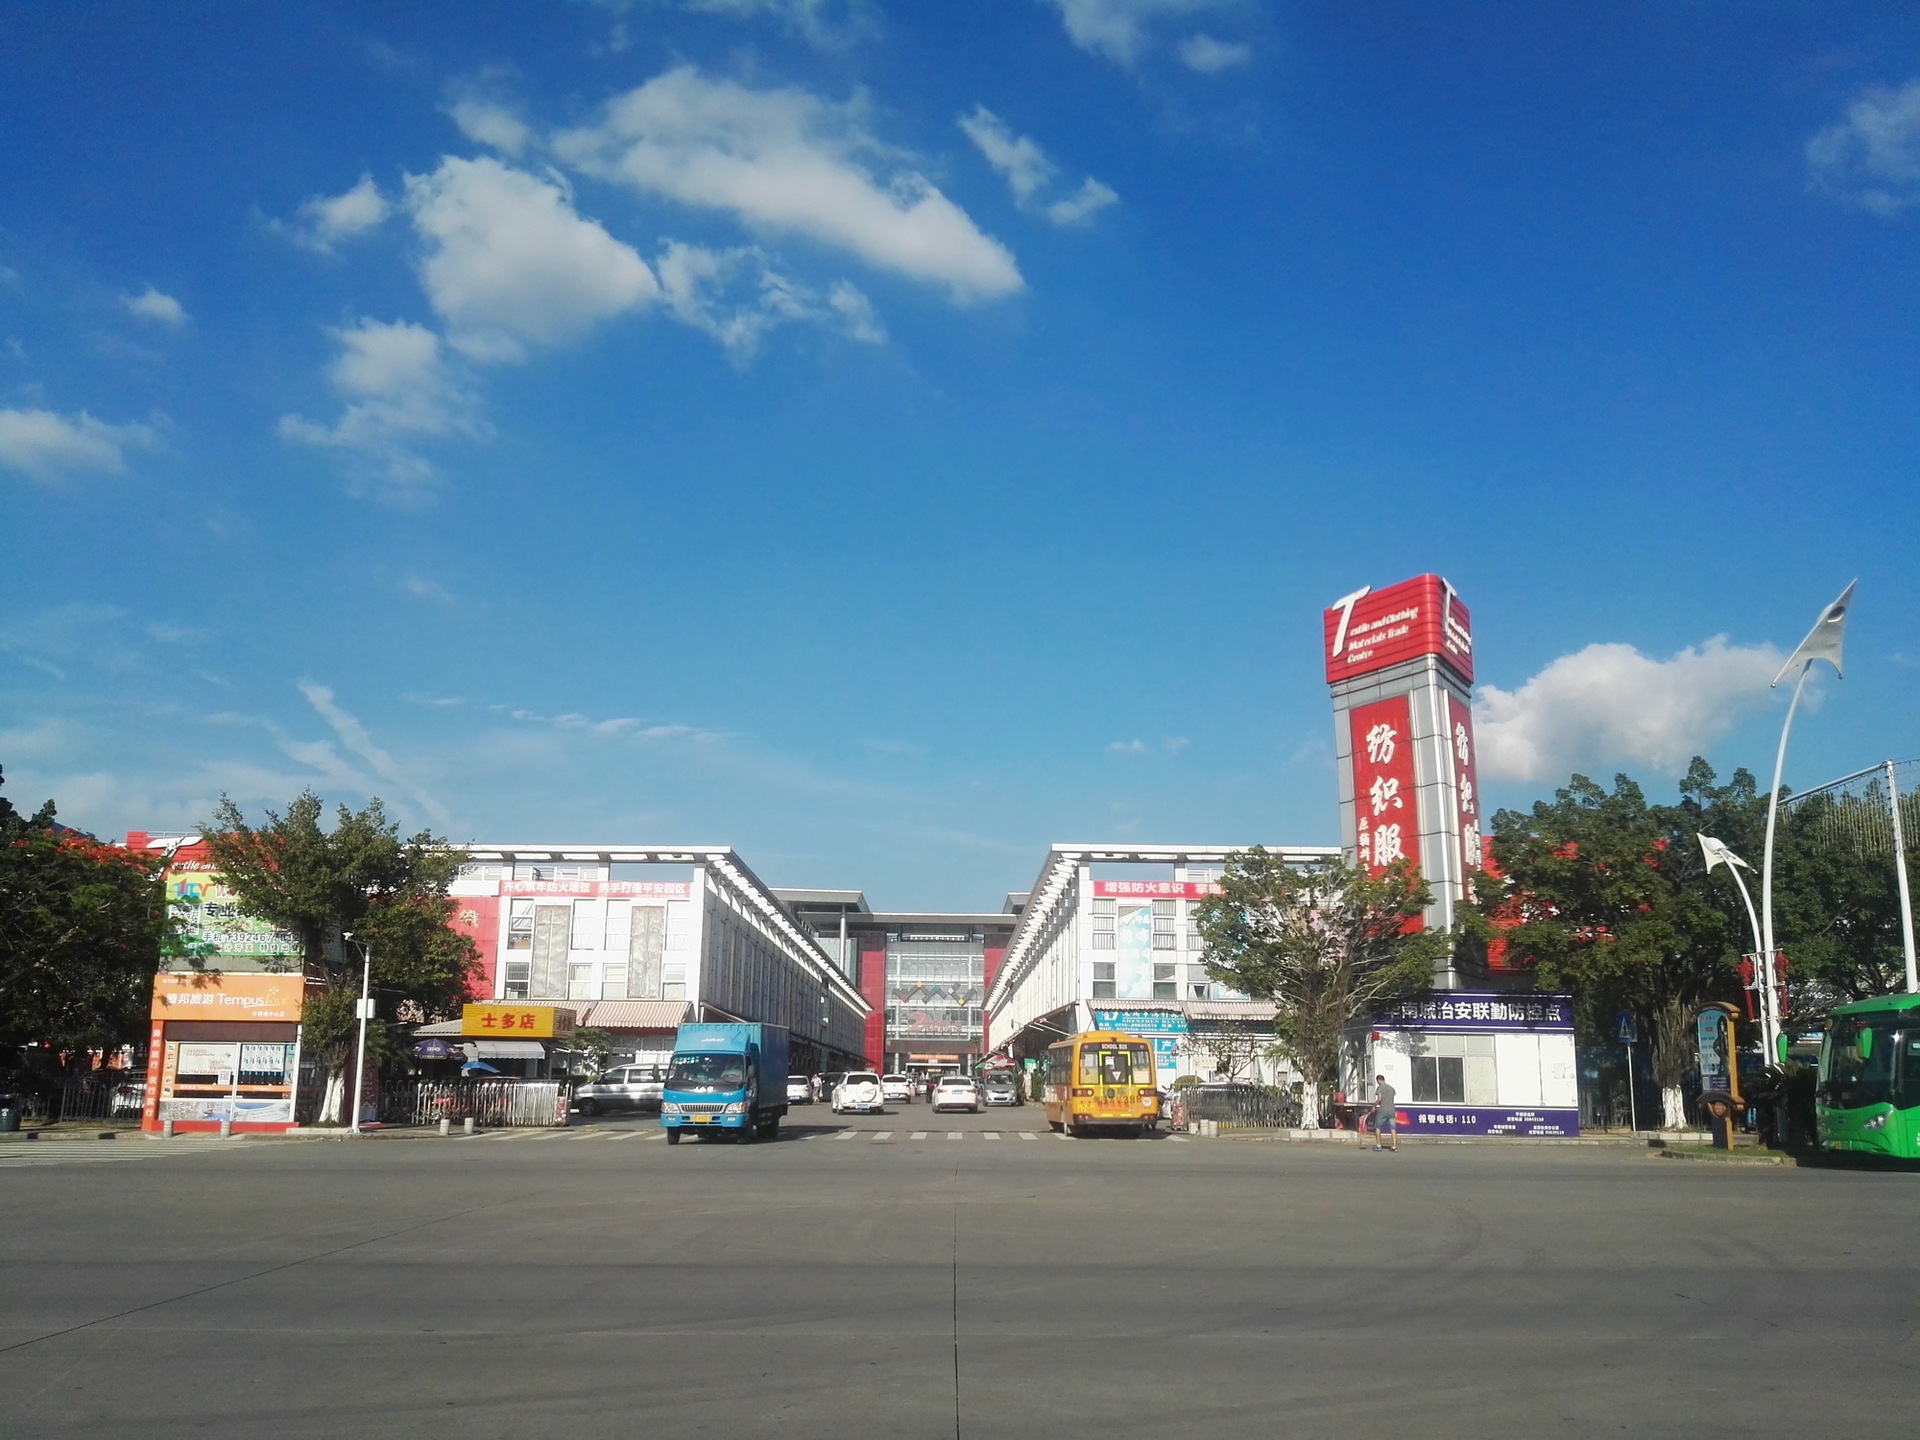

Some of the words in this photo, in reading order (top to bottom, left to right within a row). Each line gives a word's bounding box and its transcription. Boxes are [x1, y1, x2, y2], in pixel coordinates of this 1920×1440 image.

[1371, 616, 1386, 629] and
[1386, 606, 1419, 624] Clothing
[1348, 632, 1386, 652] Materials
[1387, 624, 1409, 638] Trade
[1347, 650, 1374, 663] Centre
[1105, 881, 1184, 893] 增强防火意识
[217, 993, 264, 1008] Tempus
[481, 1012, 536, 1029] 士多店
[1461, 1115, 1477, 1124] 110
